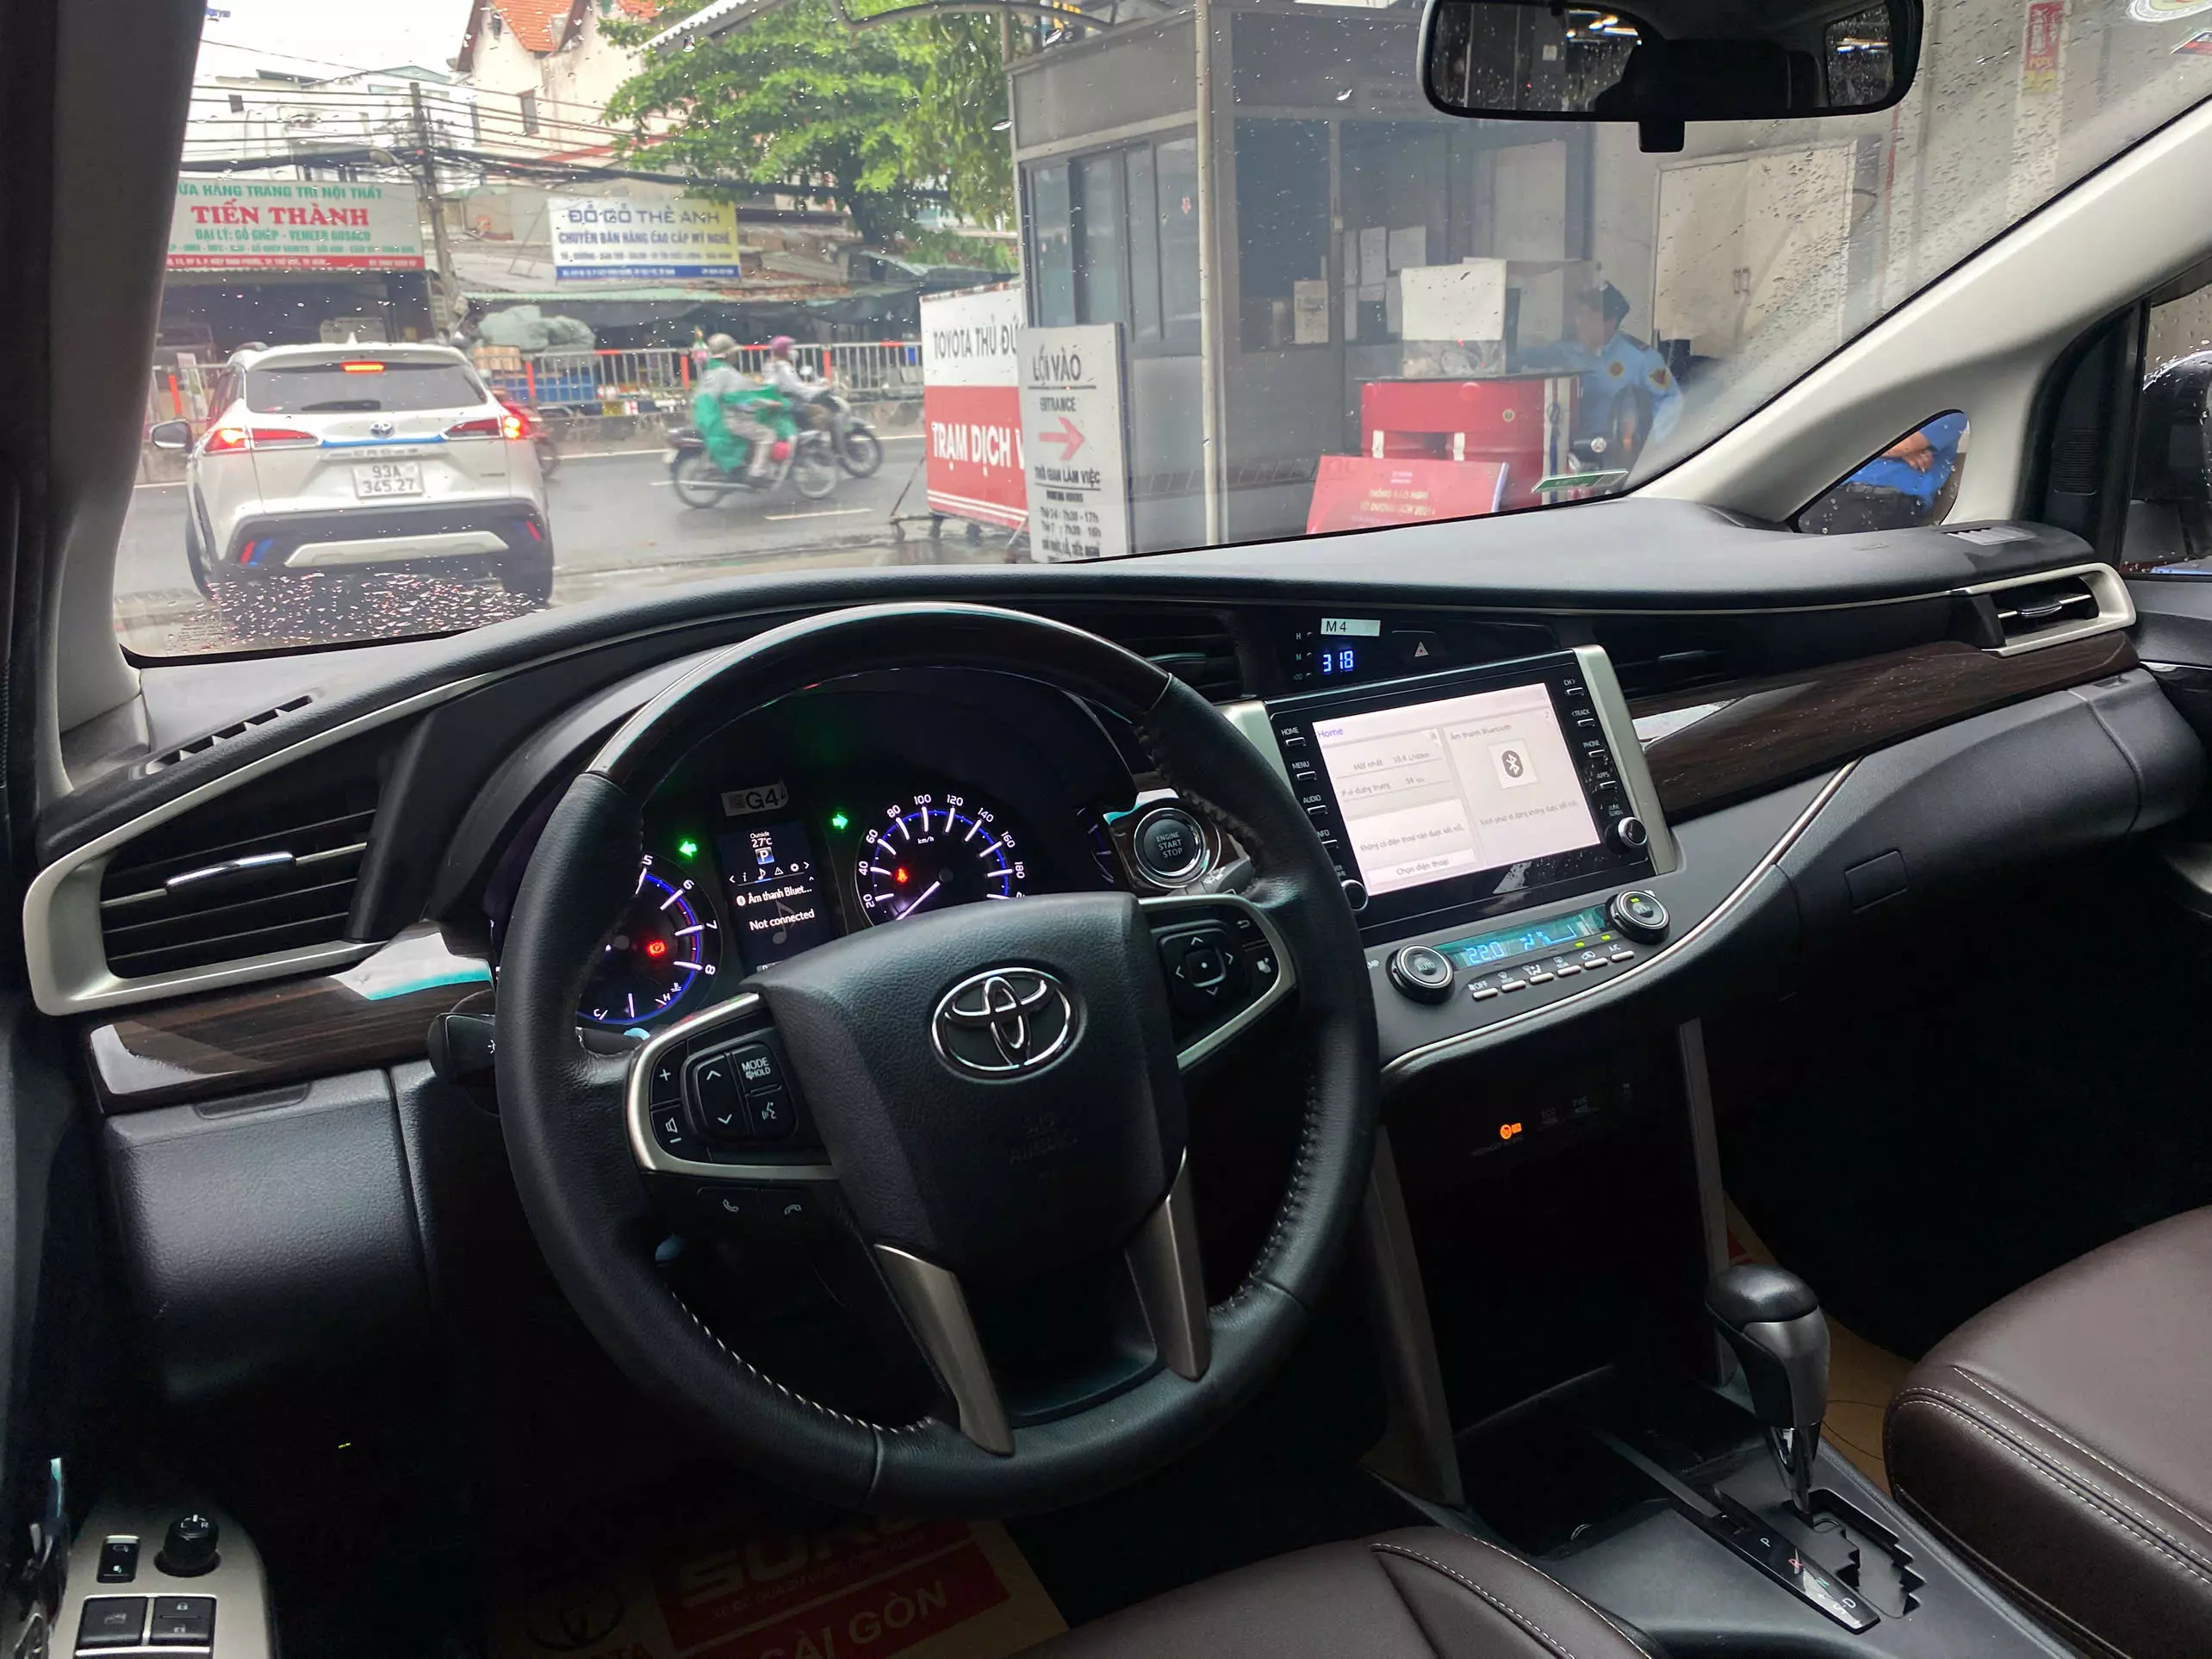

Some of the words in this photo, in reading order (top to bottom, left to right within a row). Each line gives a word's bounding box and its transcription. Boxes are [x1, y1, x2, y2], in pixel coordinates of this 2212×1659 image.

[246, 184, 292, 198] TRANG
[190, 196, 259, 224] TIẾN
[268, 202, 369, 226] THÀNH
[680, 210, 720, 224] ANH
[933, 329, 972, 359] TOYOTA
[975, 314, 997, 357] THỦ
[1051, 346, 1081, 382] VÀO
[931, 420, 968, 471] TRẠM
[970, 424, 1011, 476] DỊCH
[1281, 726, 1299, 736] HOME
[1317, 728, 1344, 739] Home
[1582, 740, 1600, 749] PHONE
[1292, 761, 1310, 770] MENU
[745, 788, 780, 810] G4
[913, 793, 932, 806] 100
[947, 794, 964, 807] 120
[1302, 794, 1321, 804] AUDIO
[886, 805, 901, 819] 80
[977, 807, 994, 823] 140
[749, 830, 770, 840] Outside
[865, 829, 879, 844] 60
[917, 836, 935, 845] km/h
[1000, 830, 1016, 849] 160
[1156, 831, 1179, 842] ENGINE
[1318, 830, 1330, 839] NFO
[1159, 839, 1182, 851] START
[1163, 847, 1183, 859] STOP
[643, 854, 653, 866] 5
[858, 861, 868, 876] 40
[1015, 861, 1025, 879] 180
[683, 879, 694, 891] 6
[748, 892, 762, 904] Âm
[762, 888, 785, 902] thanh
[862, 893, 875, 909] 20
[705, 920, 718, 931] 7
[749, 919, 768, 931] Not
[769, 908, 816, 928] connected
[1465, 941, 1505, 965] 22.0
[705, 964, 716, 975] 8
[1416, 961, 1435, 972] AUTO
[1474, 980, 1488, 990] OFF
[662, 992, 671, 1003] H
[593, 1008, 601, 1017] C
[742, 1057, 769, 1072] MODE
[751, 1066, 771, 1079] HOLD
[1760, 1538, 1771, 1547] P
[1842, 1598, 1856, 1609] D
[848, 1578, 948, 1645] GÒN
